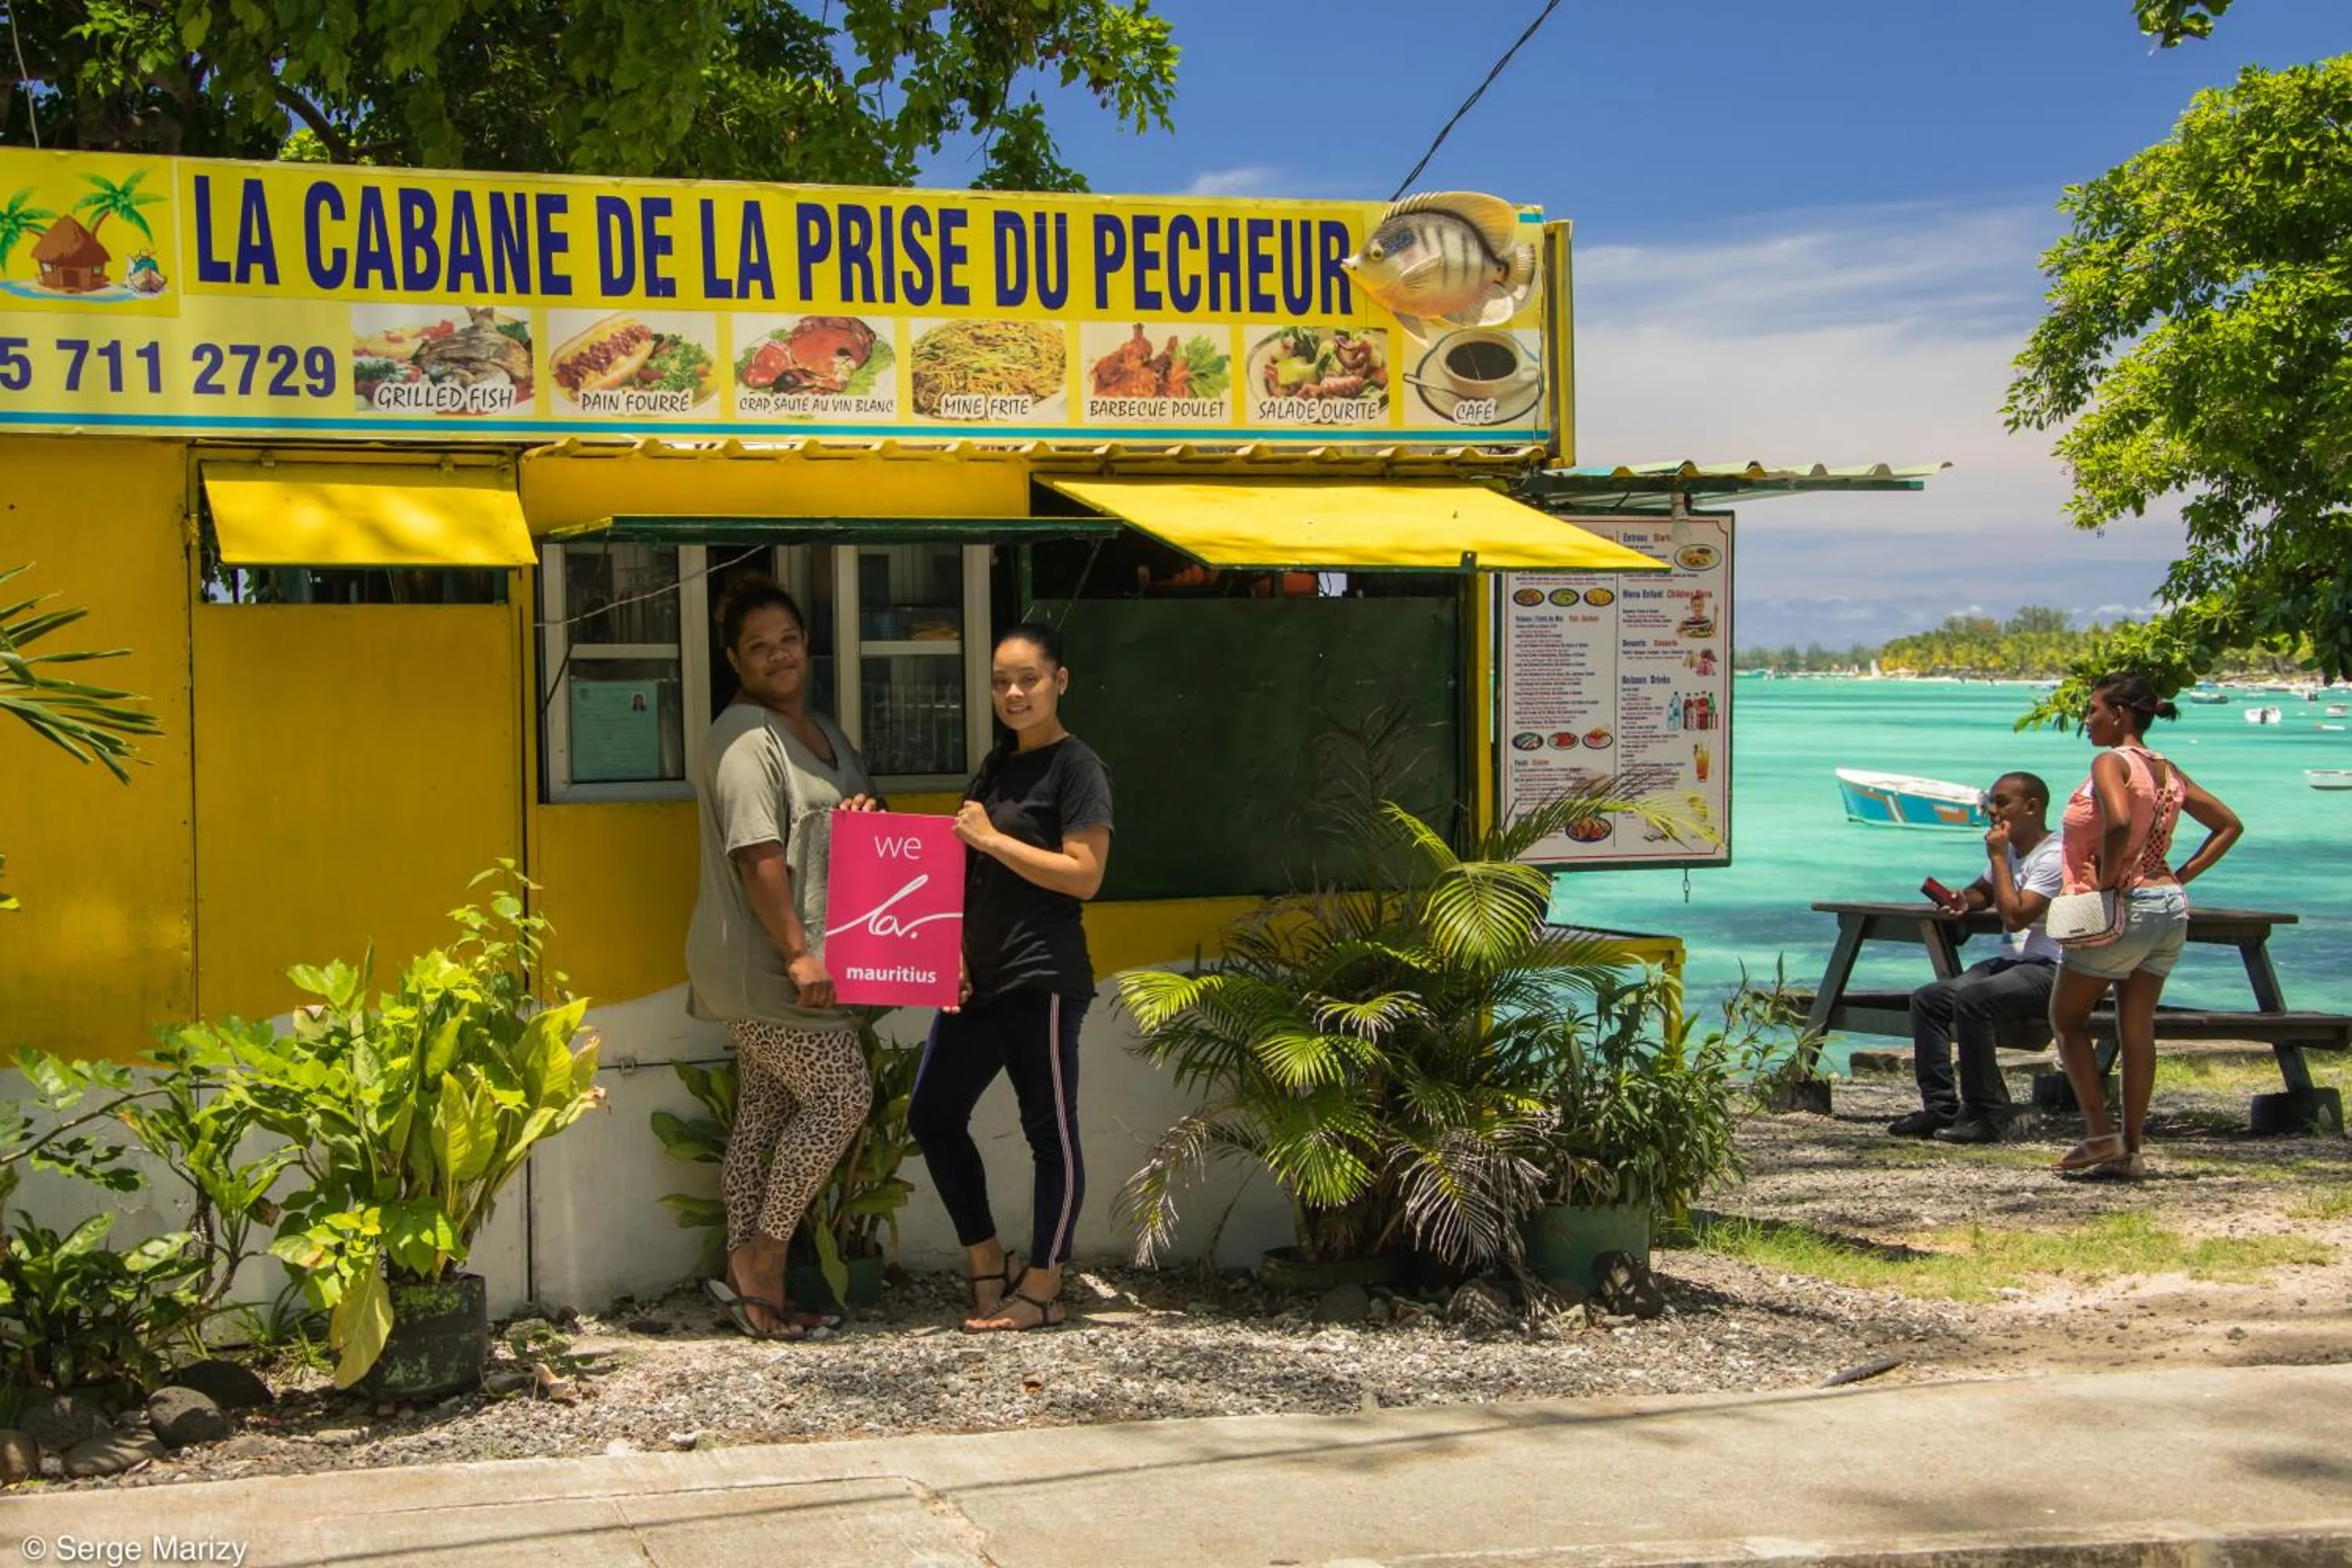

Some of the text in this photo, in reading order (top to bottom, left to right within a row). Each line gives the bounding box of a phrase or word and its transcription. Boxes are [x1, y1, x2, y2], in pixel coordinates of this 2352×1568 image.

[194, 175, 1352, 315] LA CABANE DE LA PRISE DU PECHEUR
[0, 338, 336, 397] 5 711 2729
[378, 387, 513, 409] GRILLED FISH
[582, 392, 619, 411] PAIN
[811, 398, 828, 412] AU
[832, 398, 852, 412] VIN
[855, 398, 894, 413] BLANC
[944, 397, 1029, 416] MINE FRITE
[1090, 401, 1225, 418] BARBECUE POULET
[1259, 401, 1377, 420] SALADE OURITE
[874, 835, 922, 860] we
[846, 965, 937, 984] mauritius
